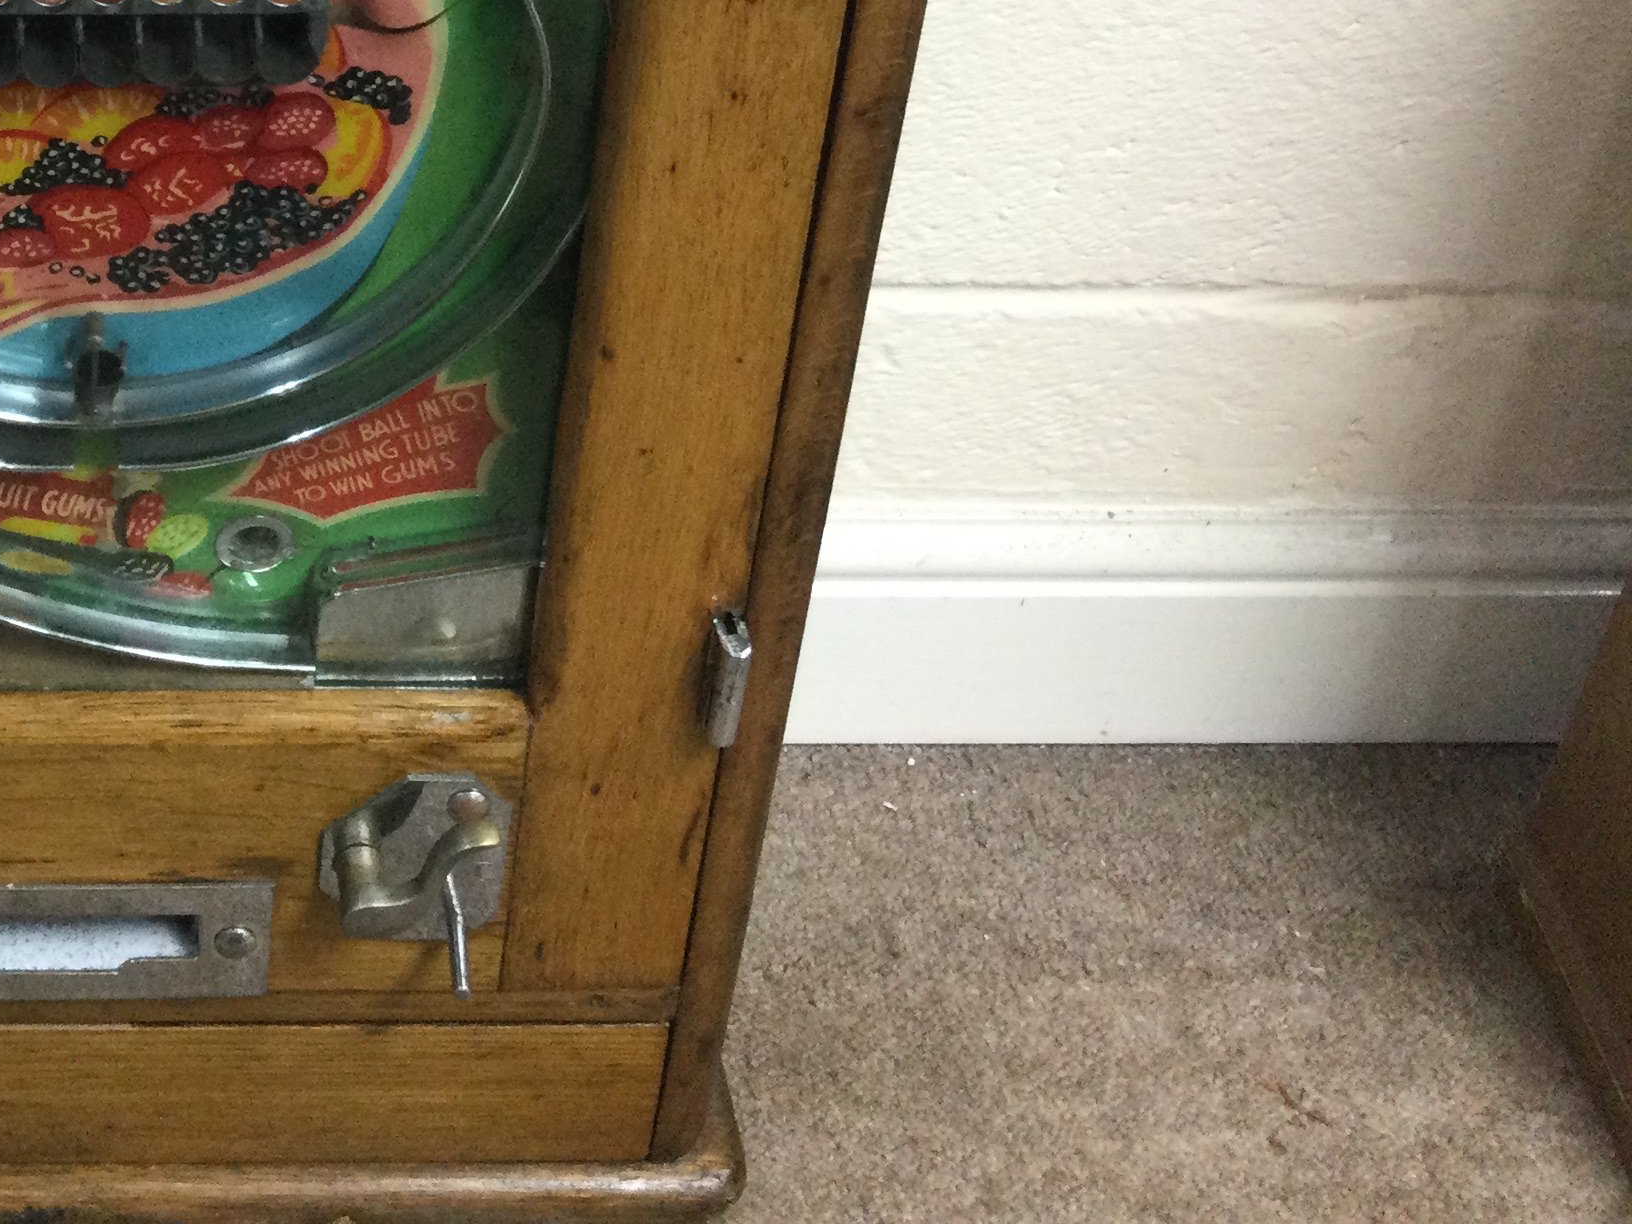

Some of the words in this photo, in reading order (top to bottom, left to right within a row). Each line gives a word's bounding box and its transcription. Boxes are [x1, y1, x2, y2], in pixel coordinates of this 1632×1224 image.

[253, 471, 292, 494] ANY
[299, 438, 400, 482] WINNING
[399, 422, 464, 455] TUBE
[269, 431, 353, 470] SHOOT
[358, 409, 412, 443] BALL
[416, 390, 479, 422] INTO
[40, 488, 111, 523] GUMS
[293, 485, 326, 505] TO
[328, 471, 374, 497] WIN
[380, 451, 457, 485] GUMS
